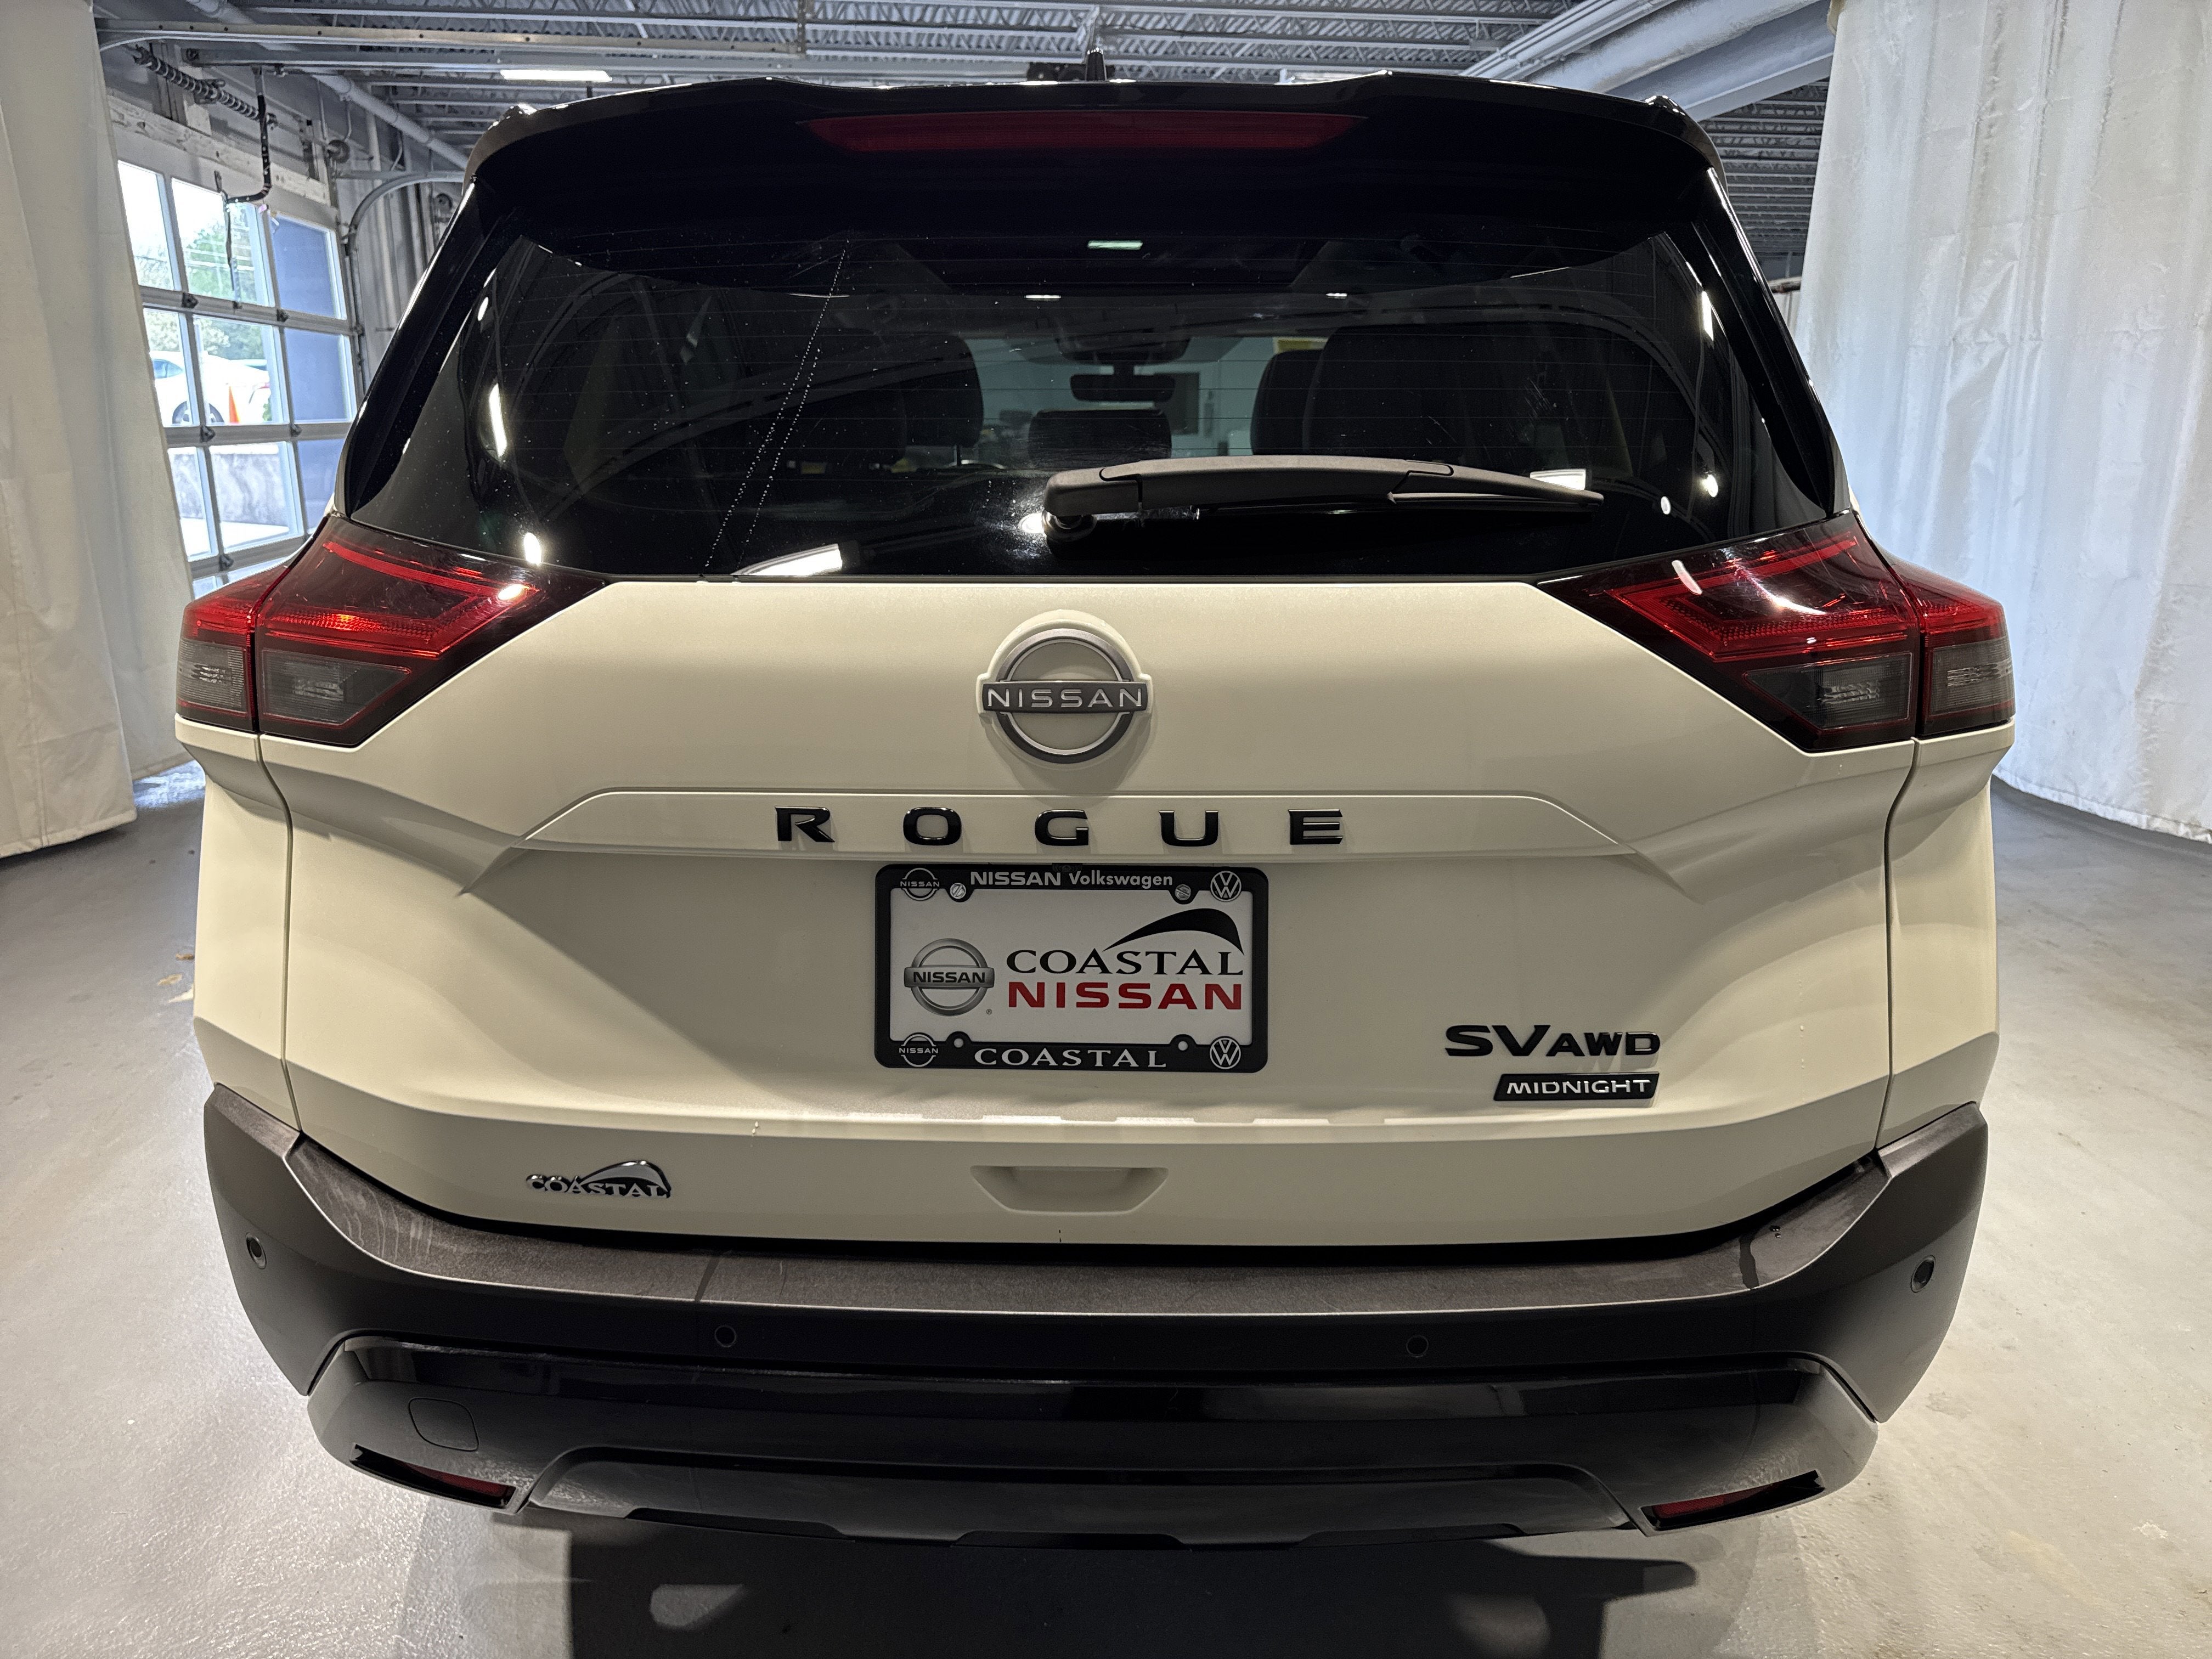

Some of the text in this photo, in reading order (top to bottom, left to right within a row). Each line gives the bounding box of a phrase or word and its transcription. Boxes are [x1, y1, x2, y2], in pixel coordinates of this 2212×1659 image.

[988, 689, 1142, 708] NISSAN
[774, 805, 1344, 848] ROGUE
[970, 870, 1173, 890] NISSAN Volkswagen
[1006, 948, 1244, 975] COASTAL
[912, 970, 986, 984] NISSAN
[1008, 981, 1242, 1010] NISSAN
[1444, 1025, 1661, 1057] SV AWD
[974, 1047, 1166, 1068] COASTAL
[1506, 1079, 1651, 1094] MIDNIGHT
[526, 1173, 672, 1199] COASTAL
